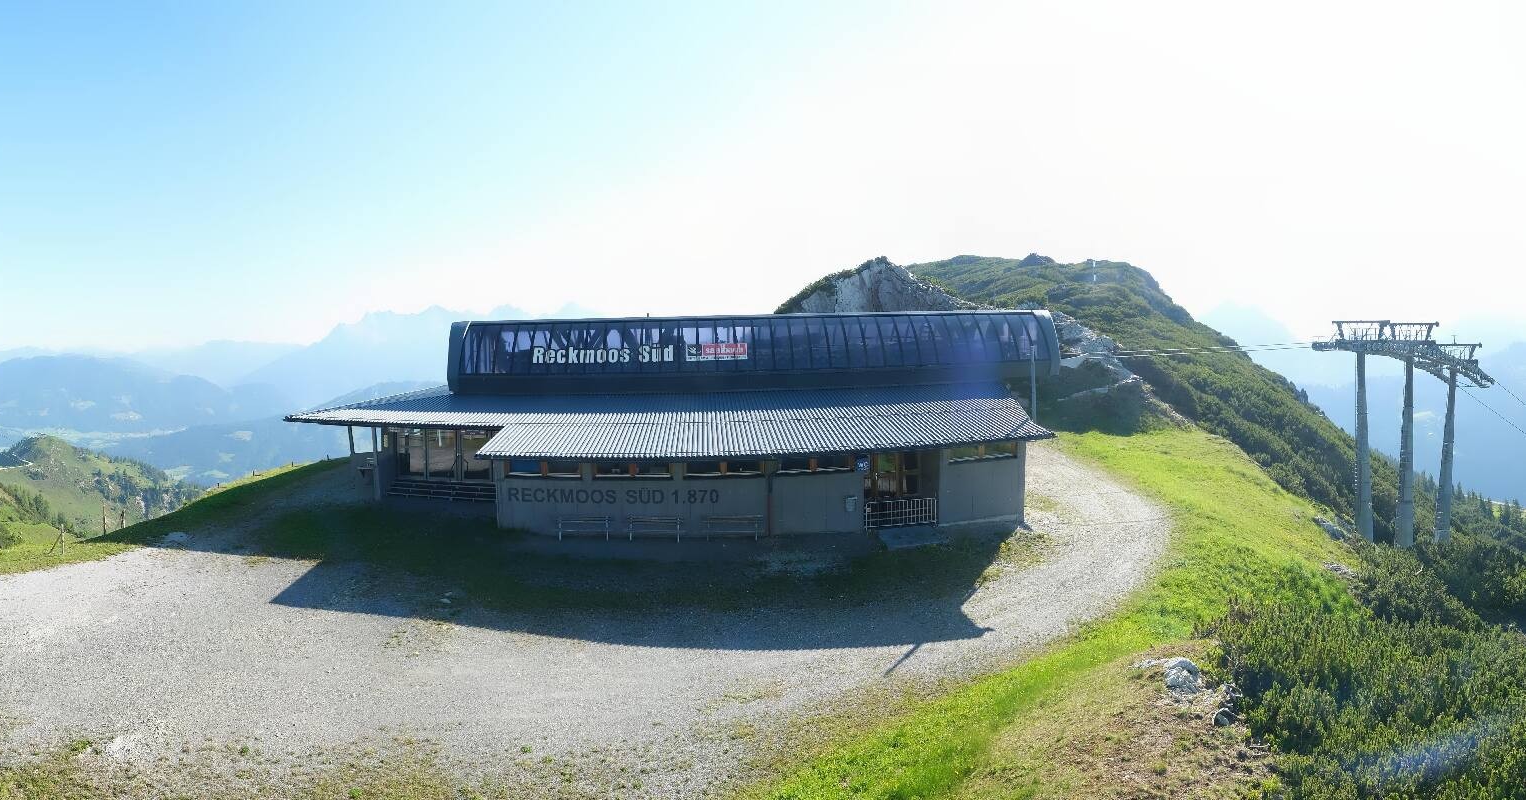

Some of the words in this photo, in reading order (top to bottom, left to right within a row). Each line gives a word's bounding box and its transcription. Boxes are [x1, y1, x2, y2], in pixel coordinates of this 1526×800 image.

[532, 346, 630, 364] Reckmoos
[638, 343, 674, 363] Süd
[507, 487, 616, 504] RECKMOOS
[626, 486, 664, 504] SÜD
[670, 488, 719, 504] 1.870
